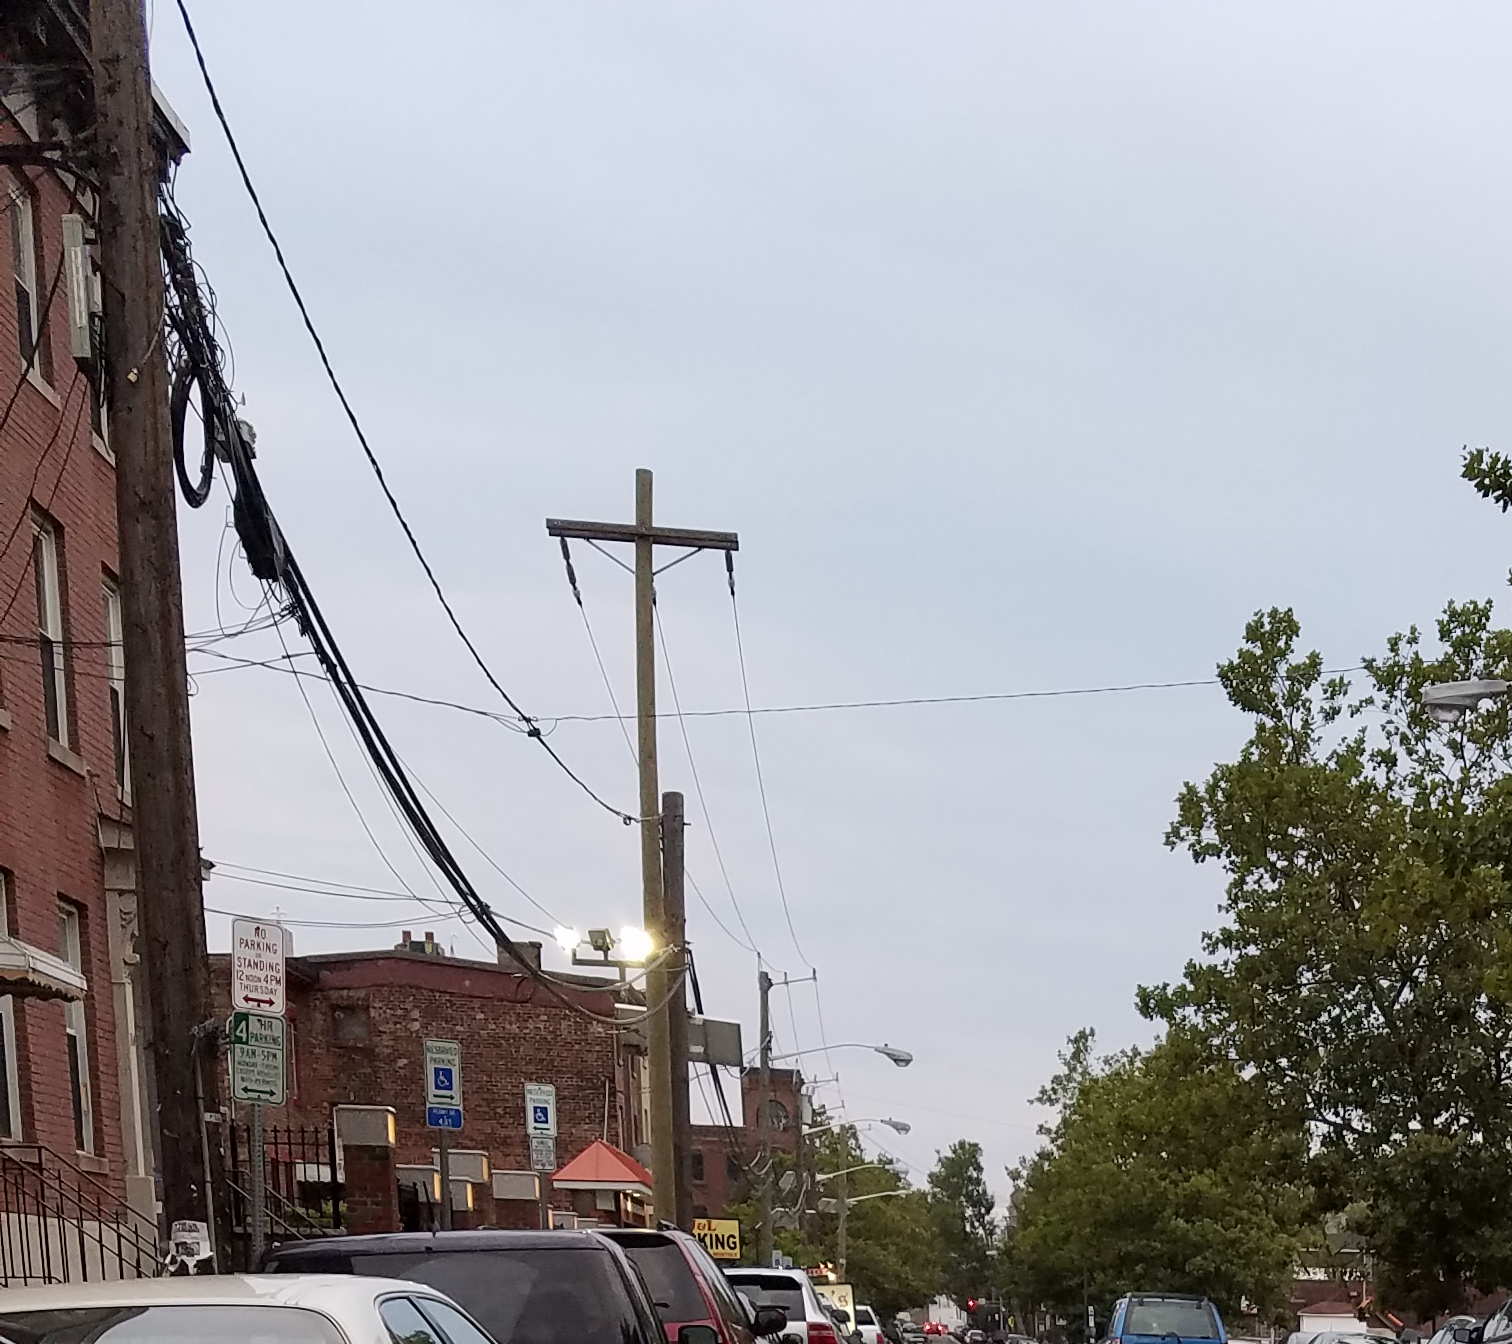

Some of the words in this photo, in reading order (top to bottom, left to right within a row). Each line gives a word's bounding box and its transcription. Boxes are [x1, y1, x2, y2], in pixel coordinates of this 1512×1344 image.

[254, 926, 267, 940] NO
[239, 938, 278, 955] PARKING
[236, 956, 281, 974] STANDING
[235, 969, 244, 982] 12
[239, 982, 278, 996] THURSDAY
[235, 1020, 247, 1042] 4
[259, 1019, 273, 1032] HR
[249, 1032, 281, 1047] PARKING
